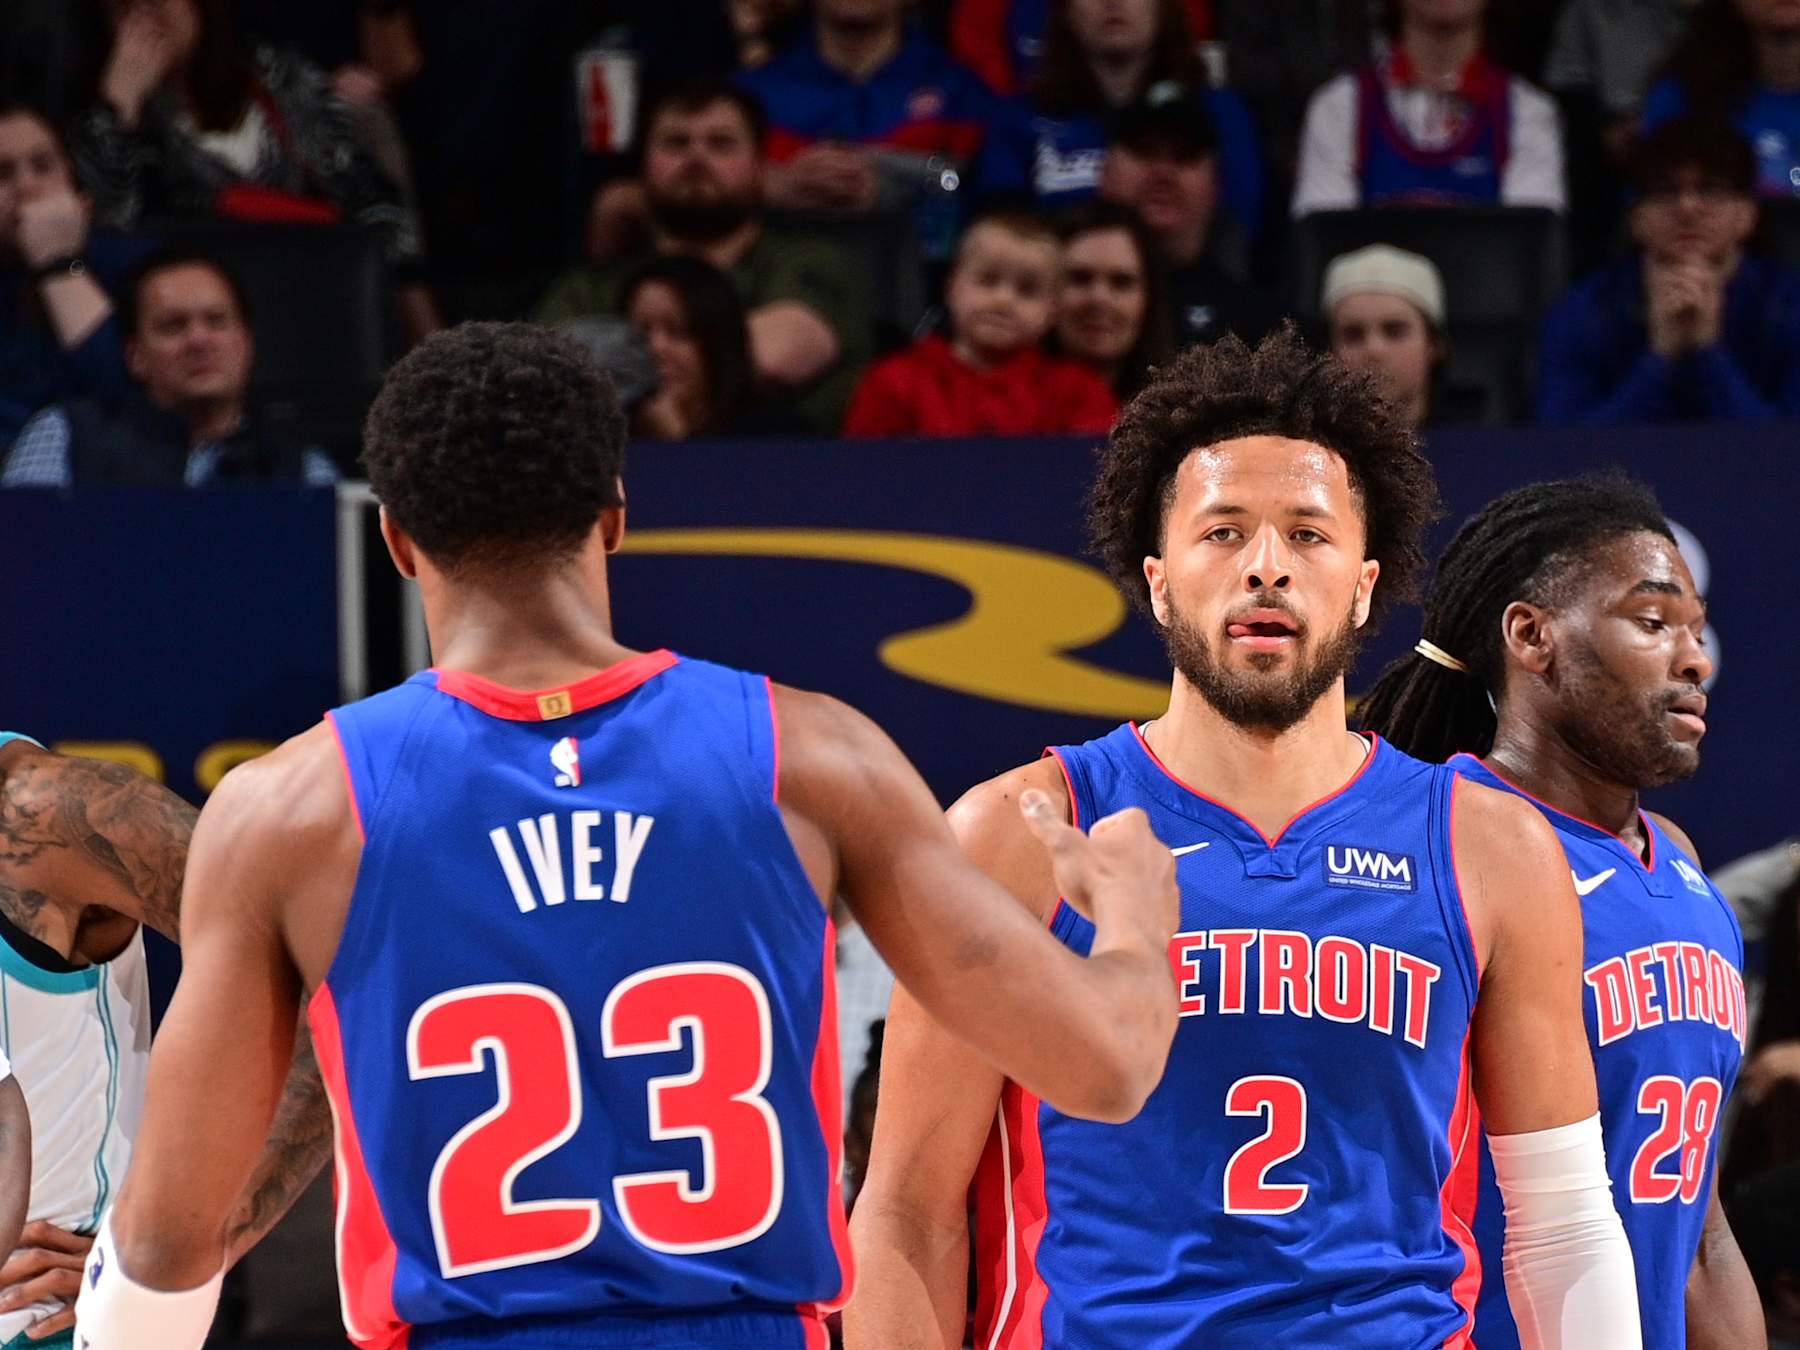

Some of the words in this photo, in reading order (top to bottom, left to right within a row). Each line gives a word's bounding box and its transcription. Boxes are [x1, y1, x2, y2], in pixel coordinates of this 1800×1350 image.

[489, 810, 655, 913] IVEY
[1327, 845, 1412, 882] UWM
[1168, 928, 1441, 1050] ETROIT
[1584, 941, 1747, 1056] DETROIT
[406, 961, 784, 1279] 23
[1223, 1075, 1309, 1215] 2
[1629, 1074, 1723, 1205] 28
